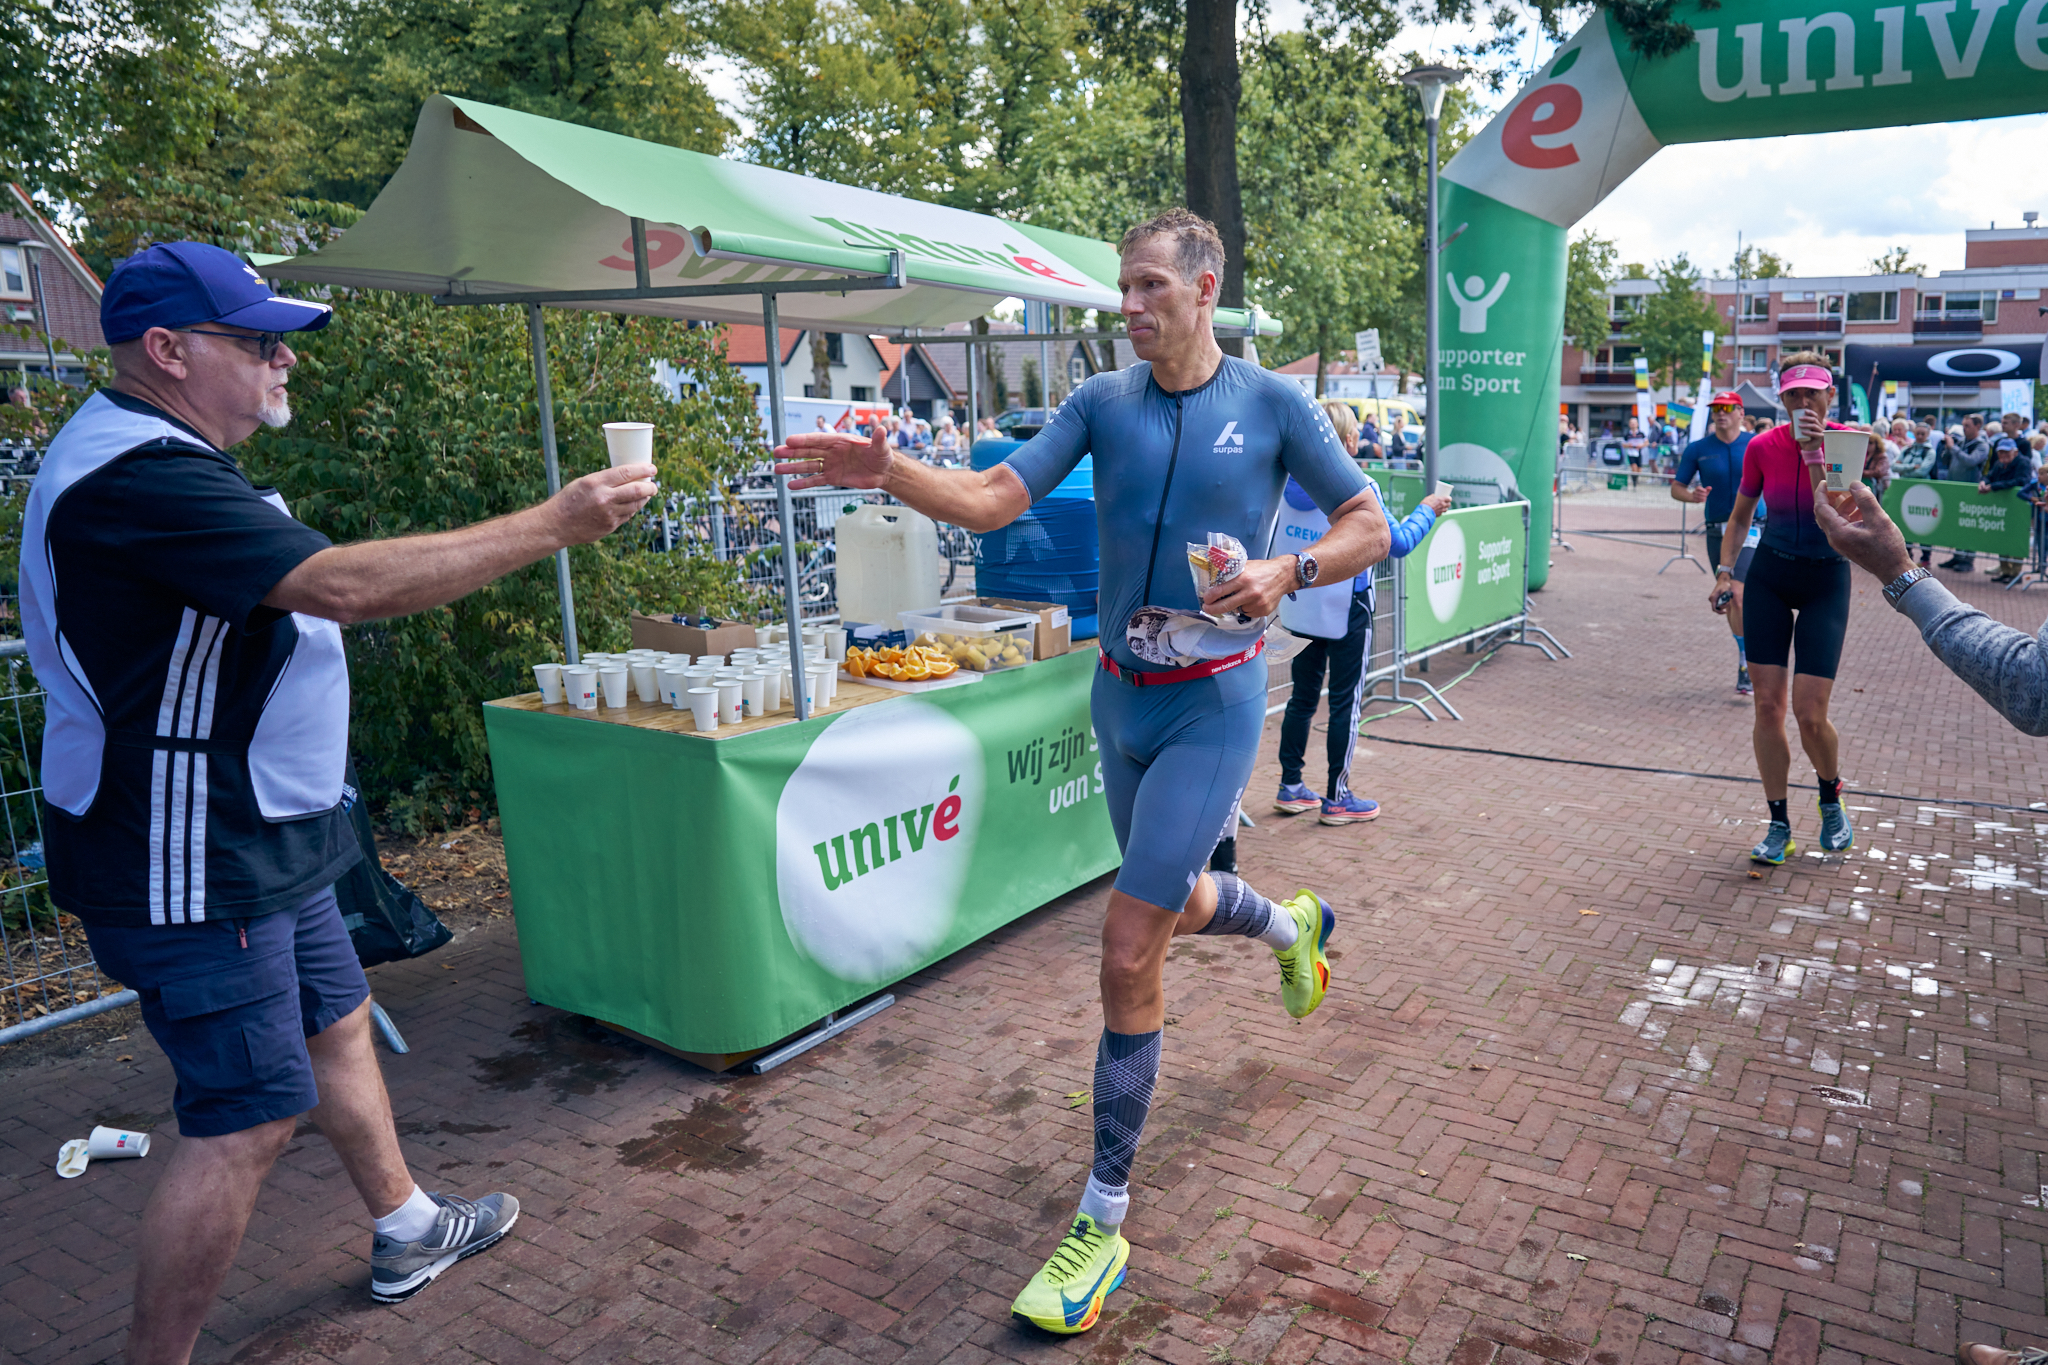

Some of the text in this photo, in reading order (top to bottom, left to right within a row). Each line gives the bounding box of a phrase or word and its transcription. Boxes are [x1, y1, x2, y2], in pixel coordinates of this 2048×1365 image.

[1438, 349, 1527, 368] upporter
[1438, 373, 1521, 396] an Sport
[1213, 446, 1243, 454] surpas
[1959, 501, 2008, 517] Supporter
[1285, 525, 1323, 541] CREW
[1958, 517, 2005, 532] van Sport
[1478, 536, 1513, 564] Supporter
[1433, 553, 1462, 585] univé
[1477, 558, 1511, 585] van Sport
[1222, 659, 1242, 670] balance
[1007, 737, 1044, 785] Wij
[1048, 726, 1085, 774] zijn
[1049, 773, 1089, 814] van
[813, 774, 962, 891] univé
[1099, 1189, 1127, 1198] CARB
